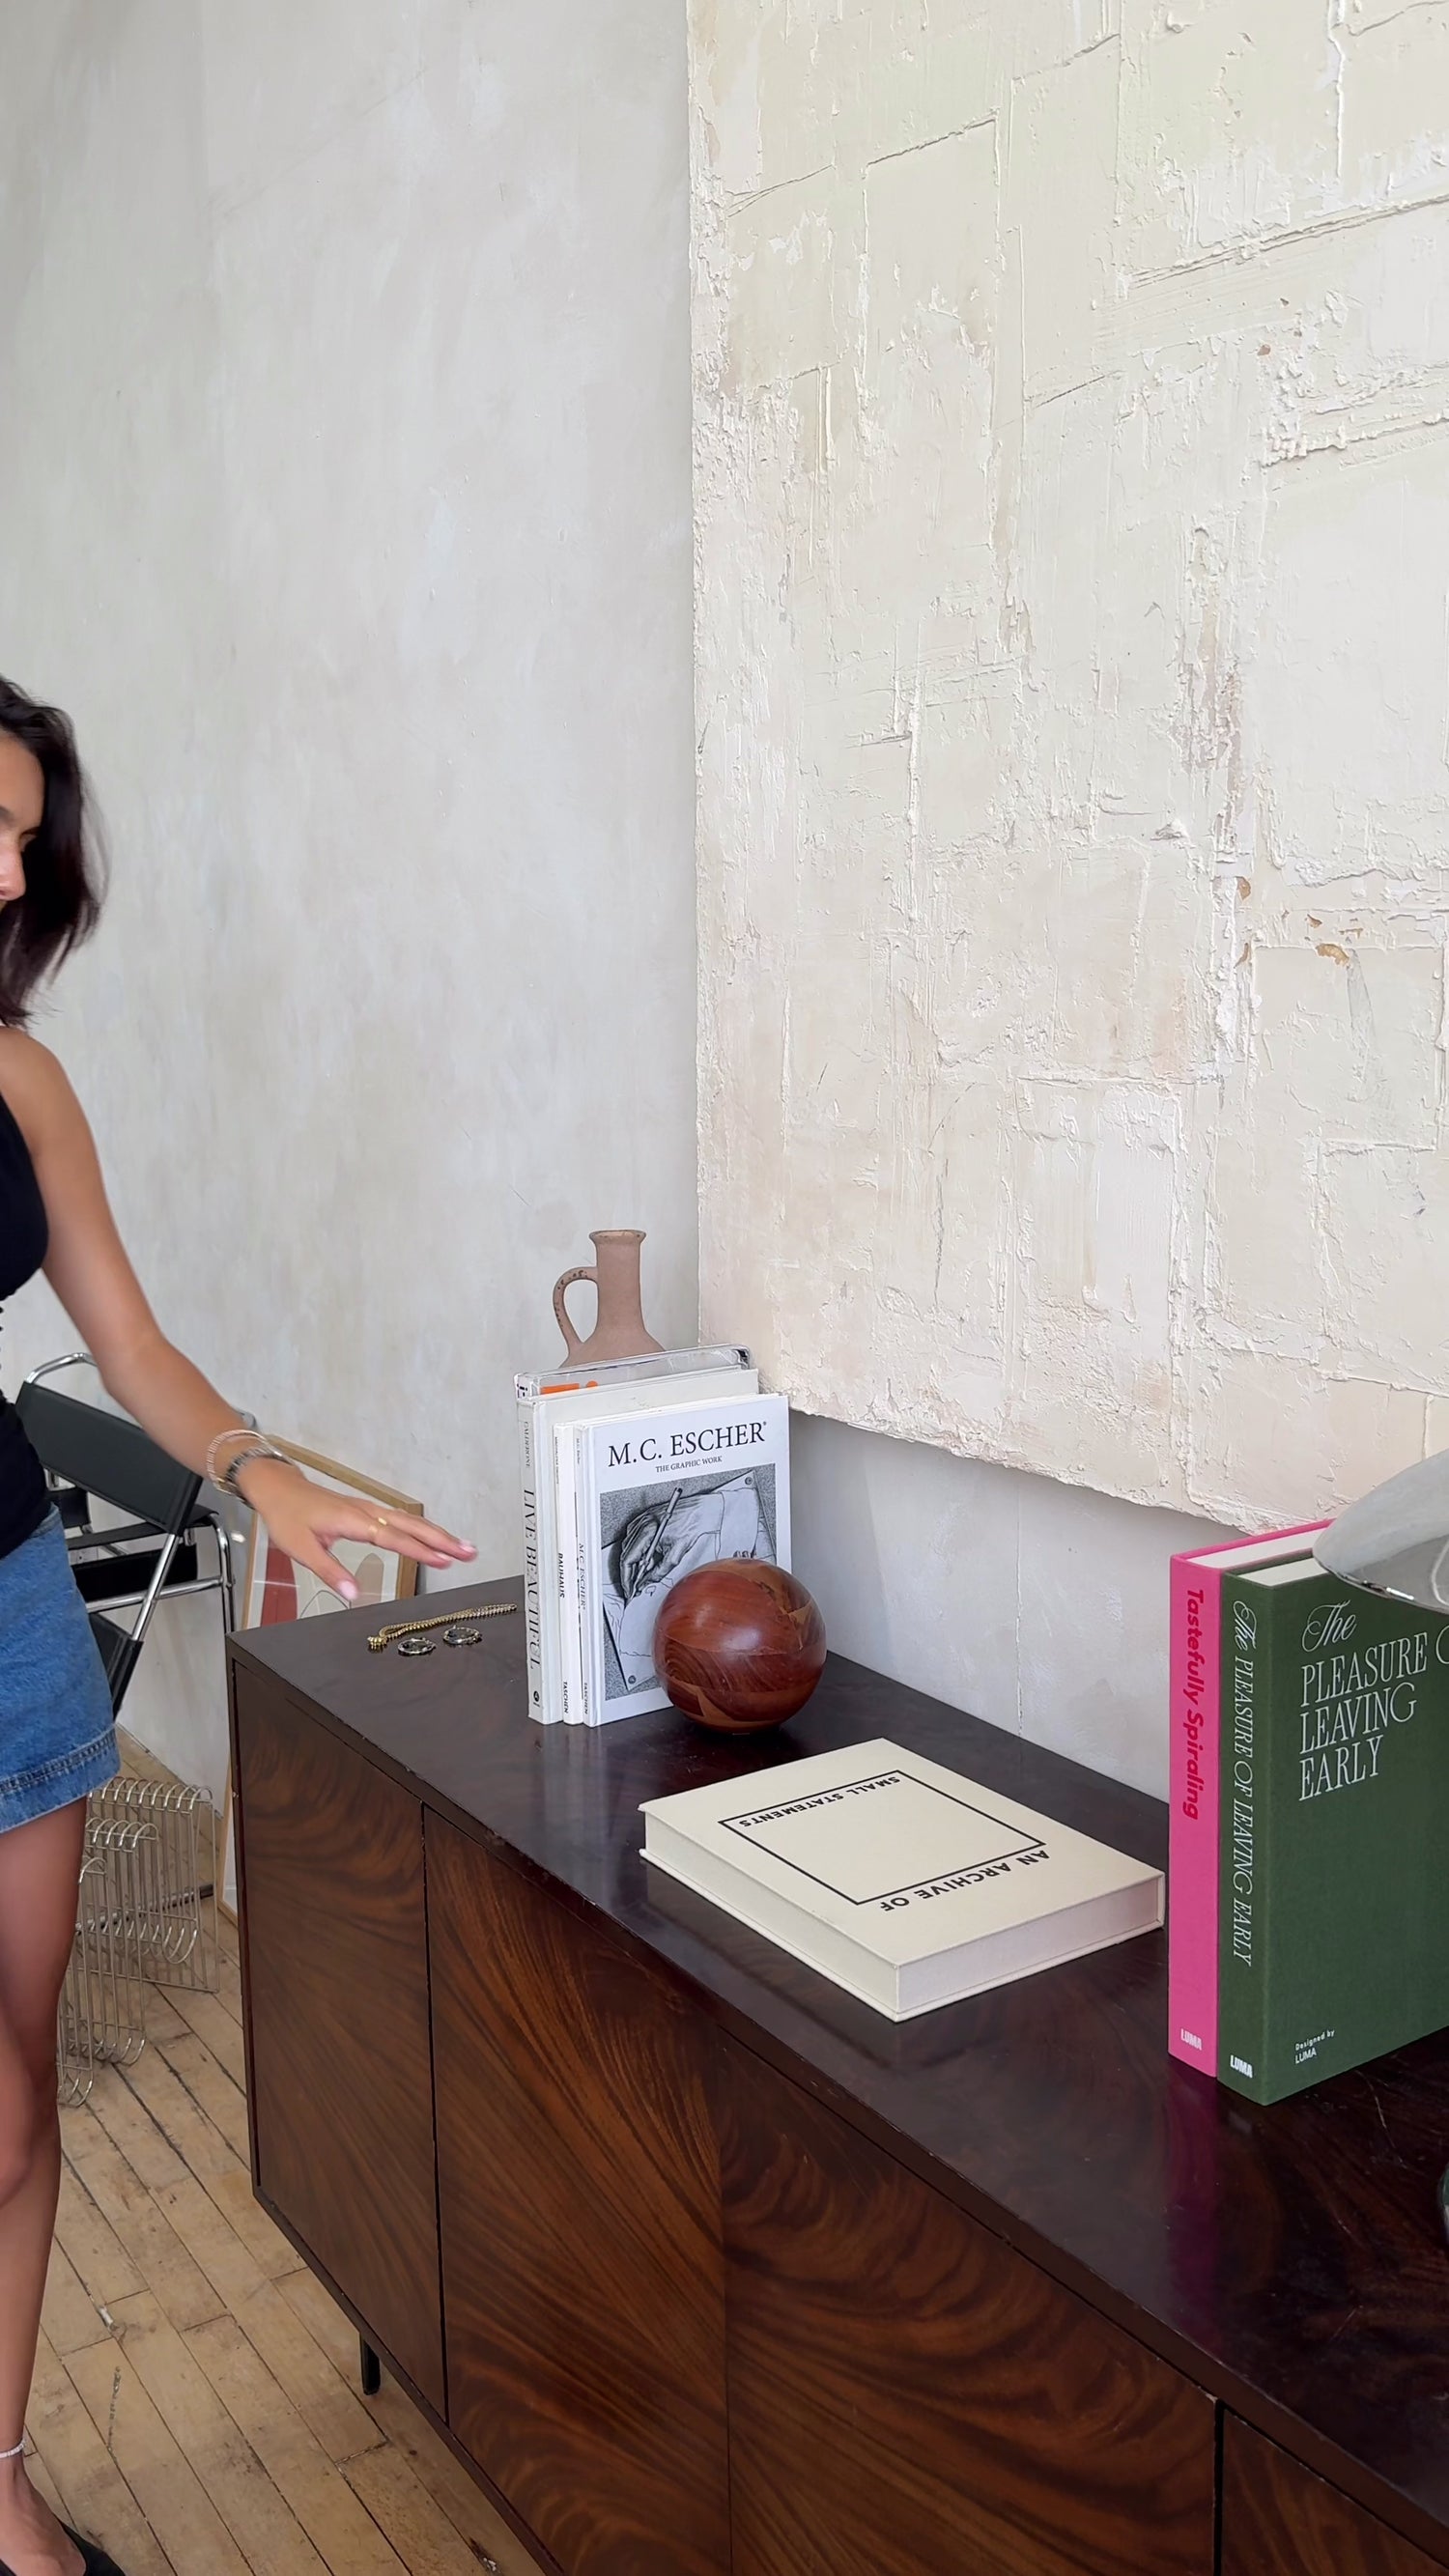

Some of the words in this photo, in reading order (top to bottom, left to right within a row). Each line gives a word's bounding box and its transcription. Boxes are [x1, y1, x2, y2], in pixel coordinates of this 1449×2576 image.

[608, 1437, 663, 1467] M.C.
[655, 1463, 670, 1473] THE
[670, 1458, 701, 1471] GRAPHIC
[701, 1456, 723, 1465] WORK
[524, 1489, 536, 1541] LIVE
[526, 1546, 541, 1669] BEAUTIFUL
[1233, 1600, 1257, 1652] The
[1301, 1599, 1357, 1653] The
[1183, 1589, 1205, 1705] Tastefully
[1300, 1631, 1428, 1708] PLEASURE
[1234, 1656, 1254, 1759] PLEASURE
[1299, 1682, 1417, 1754] LEAVING
[845, 1775, 900, 1796] SMALL
[1182, 1709, 1205, 1820] Spiraling
[1234, 1761, 1254, 1798] OF
[1298, 1735, 1383, 1801] EARLY
[739, 1792, 844, 1827] STATEMENTS
[1015, 1849, 1050, 1865] AN
[1233, 1798, 1254, 1895] LEAVING
[914, 1861, 1011, 1900] ARCHIVE
[880, 1896, 910, 1911] OF
[1233, 1897, 1253, 1968] EARLY
[1180, 2028, 1203, 2051] LUMA
[1294, 2030, 1325, 2052] Designed
[1326, 2028, 1335, 2038] by
[1294, 2047, 1317, 2064] LUMA
[1230, 2054, 1253, 2079] LUMA
